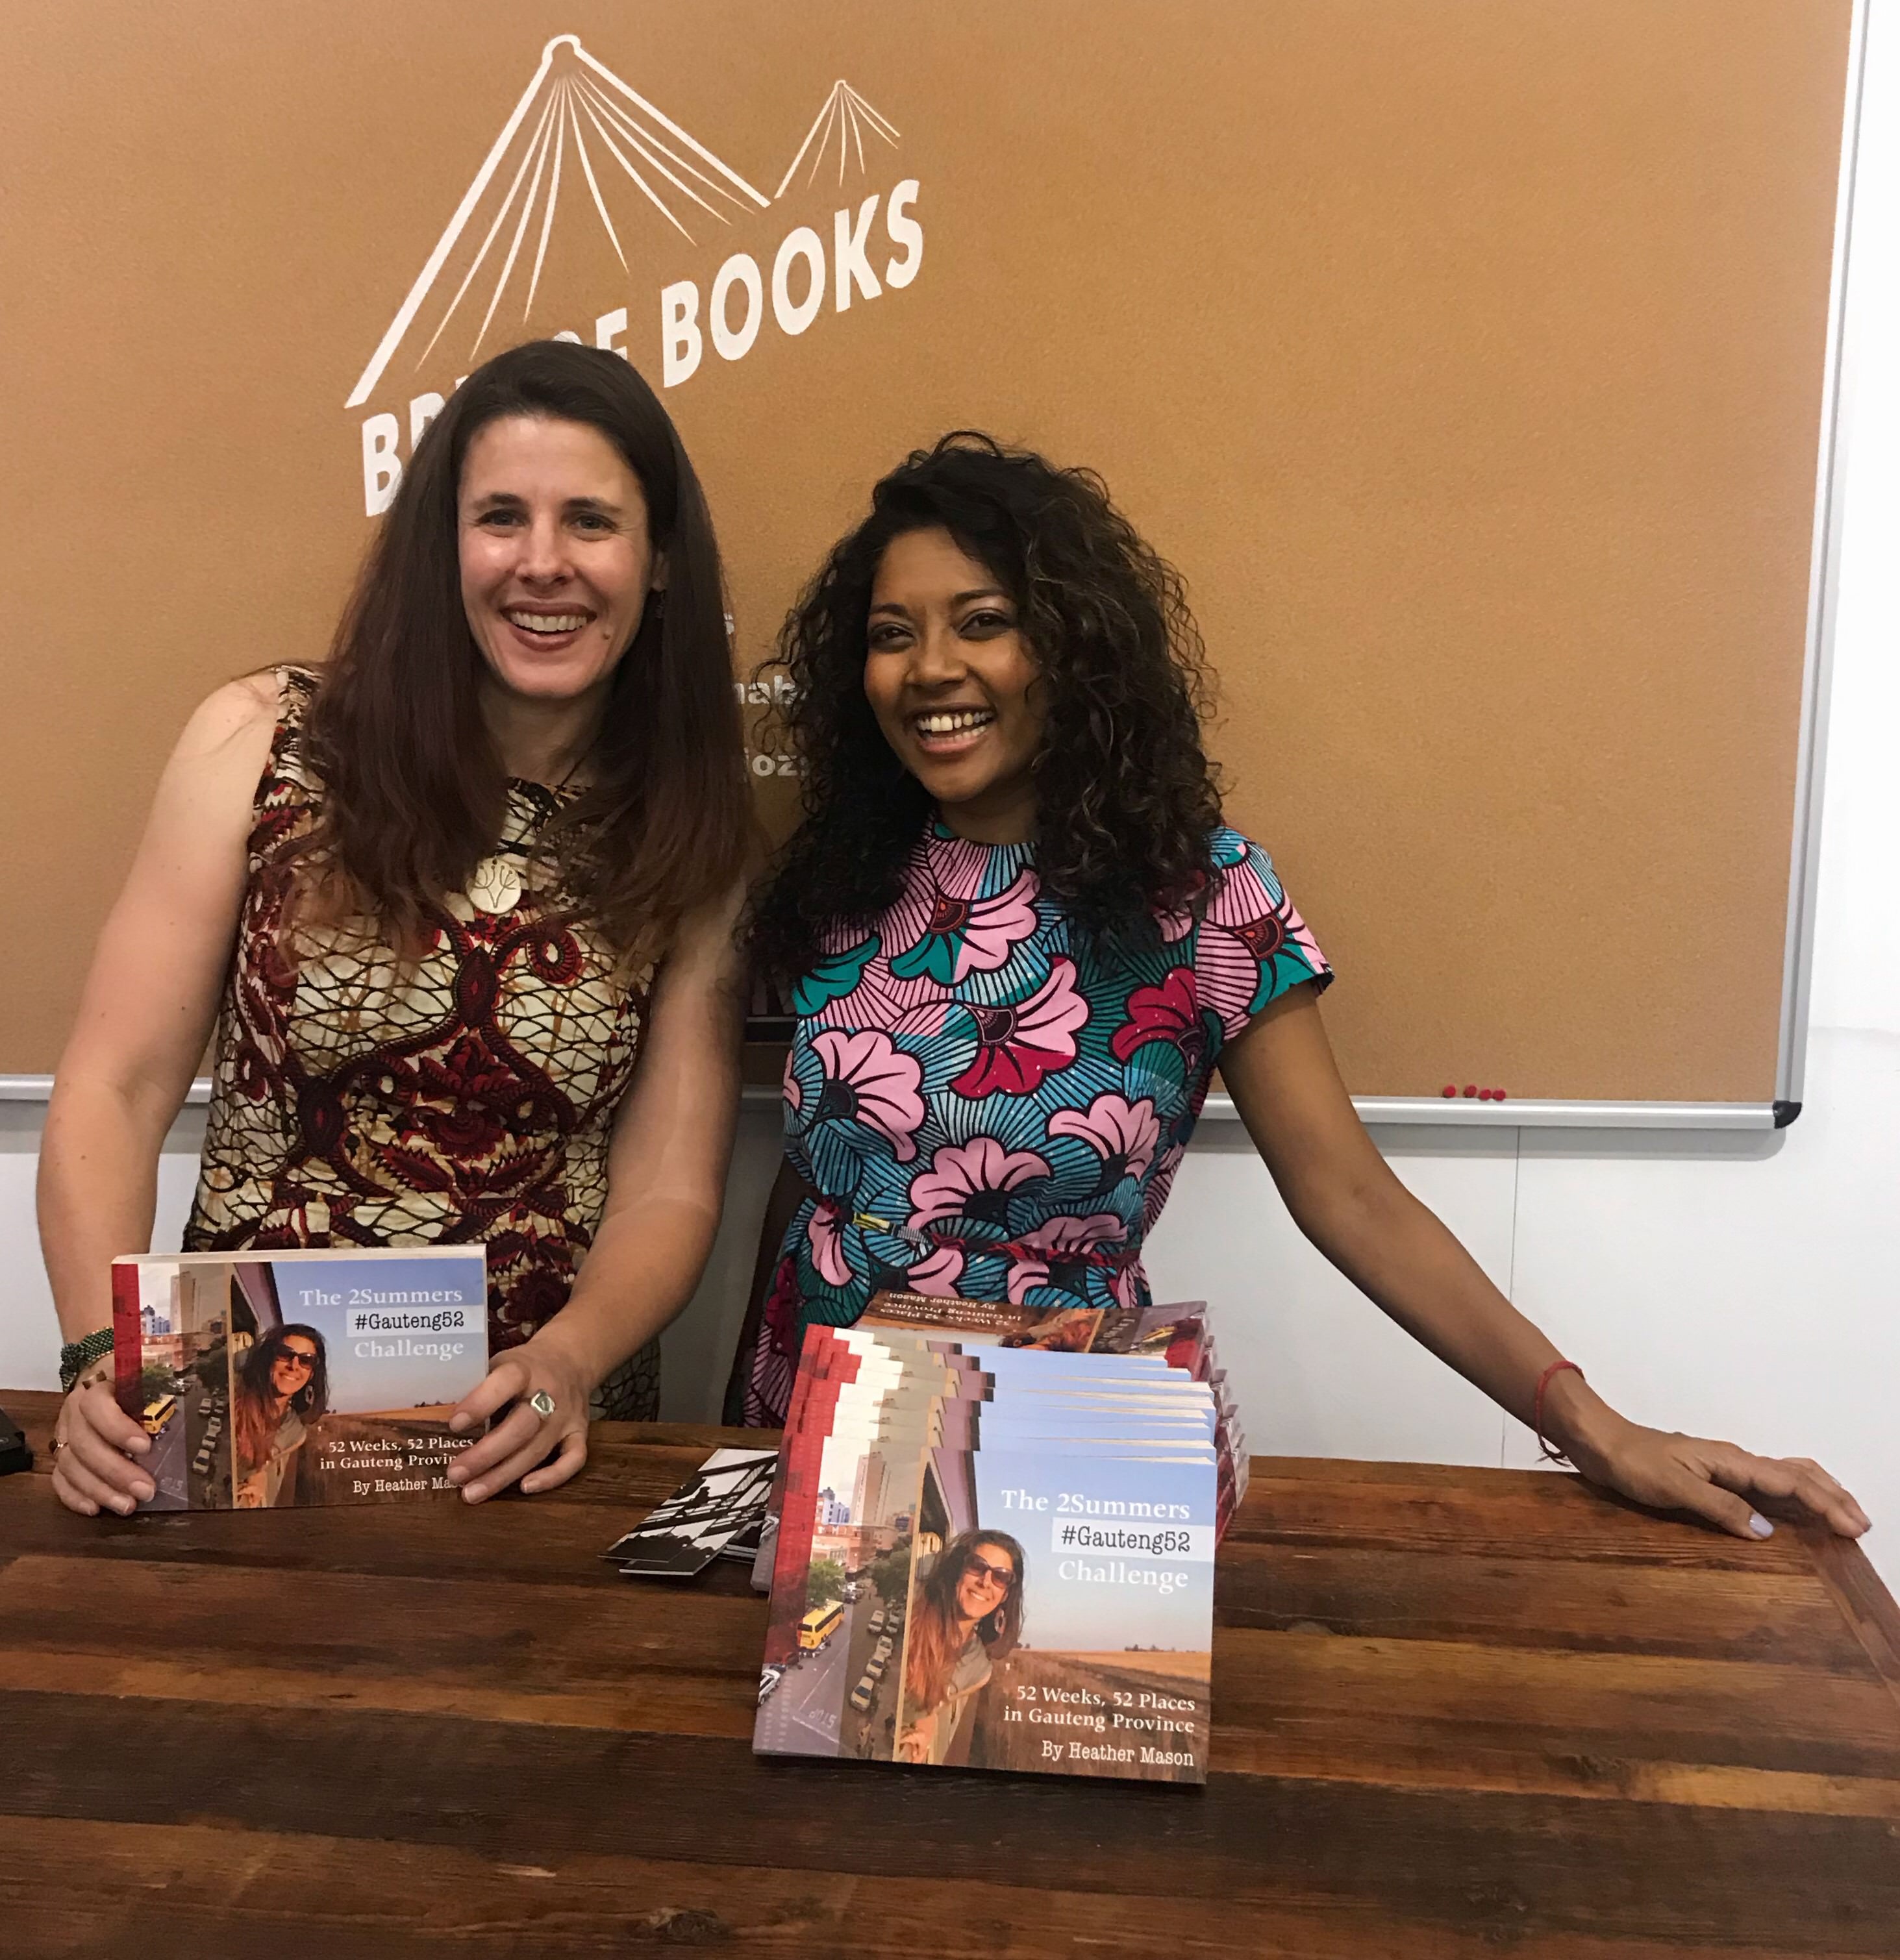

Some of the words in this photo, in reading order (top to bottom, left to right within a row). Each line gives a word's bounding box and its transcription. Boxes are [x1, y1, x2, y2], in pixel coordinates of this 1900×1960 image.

[661, 179, 924, 388] BOOKS
[299, 1289, 342, 1306] The
[347, 1287, 464, 1306] 2Summers
[889, 1293, 927, 1303] Mason
[929, 1297, 977, 1309] Heather
[880, 1308, 921, 1319] Places
[883, 1302, 942, 1315] Province
[947, 1308, 1003, 1320] Gauteng
[980, 1302, 997, 1311] By
[355, 1310, 465, 1332] #Gauteng52
[354, 1339, 464, 1361] Challenge
[329, 1441, 345, 1453] 52
[349, 1439, 403, 1452] Weeks,
[407, 1438, 423, 1450] 52
[427, 1436, 473, 1449] Places
[319, 1458, 335, 1470] in
[340, 1457, 403, 1471] Gauteng
[353, 1480, 371, 1496] By
[374, 1478, 428, 1493] Heather
[1001, 1489, 1049, 1511] The
[1056, 1493, 1190, 1520] 2Summers
[1060, 1524, 1191, 1556] #Gauteng52
[1058, 1559, 1189, 1594] Challenge
[1017, 1685, 1036, 1701] 52
[1041, 1687, 1106, 1707] Weeks,
[1112, 1691, 1133, 1707] 52
[1138, 1693, 1195, 1711] Places
[1003, 1705, 1023, 1722] in
[1028, 1707, 1106, 1733] Gauteng
[1111, 1713, 1195, 1733] Province
[1041, 1739, 1064, 1762] By
[1068, 1741, 1136, 1763] Heather
[1140, 1746, 1195, 1767] Mason
